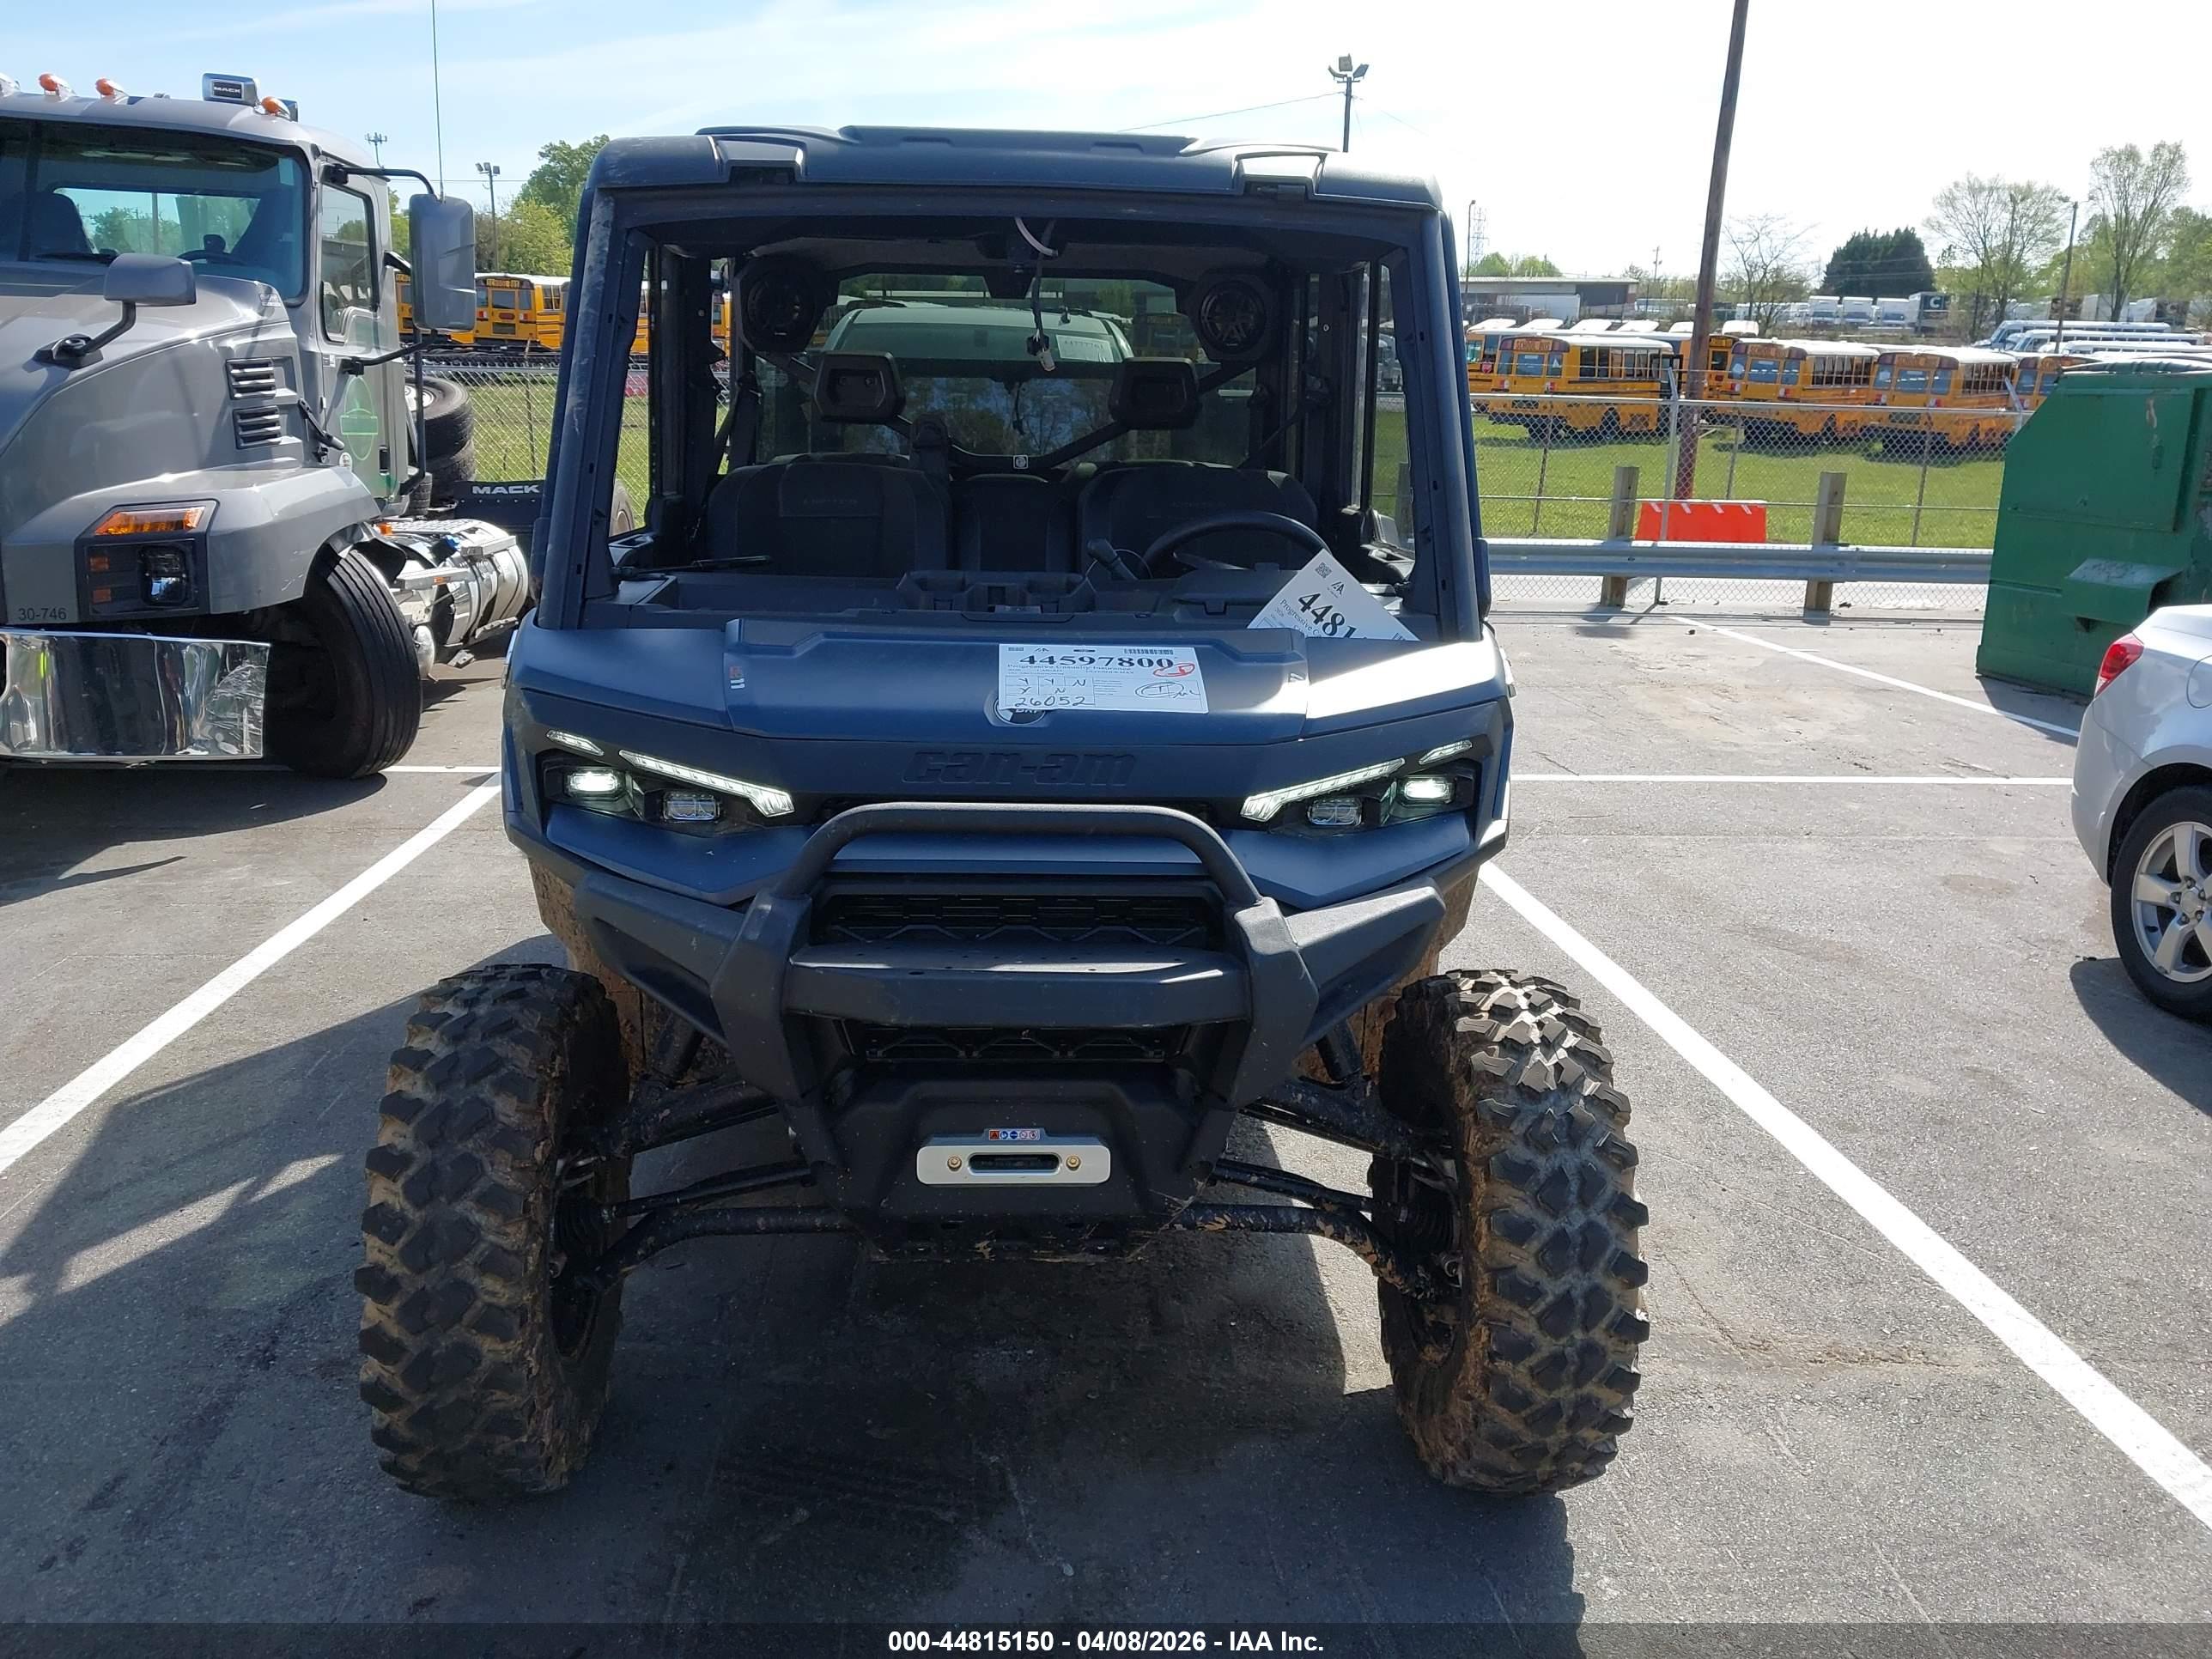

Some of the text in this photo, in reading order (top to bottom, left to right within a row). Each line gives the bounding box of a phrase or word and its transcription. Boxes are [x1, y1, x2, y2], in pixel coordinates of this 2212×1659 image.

[472, 484, 540, 494] MACK
[18, 607, 67, 621] 30-746
[1019, 655, 1174, 668] 44597800
[1015, 696, 1096, 707] 26052
